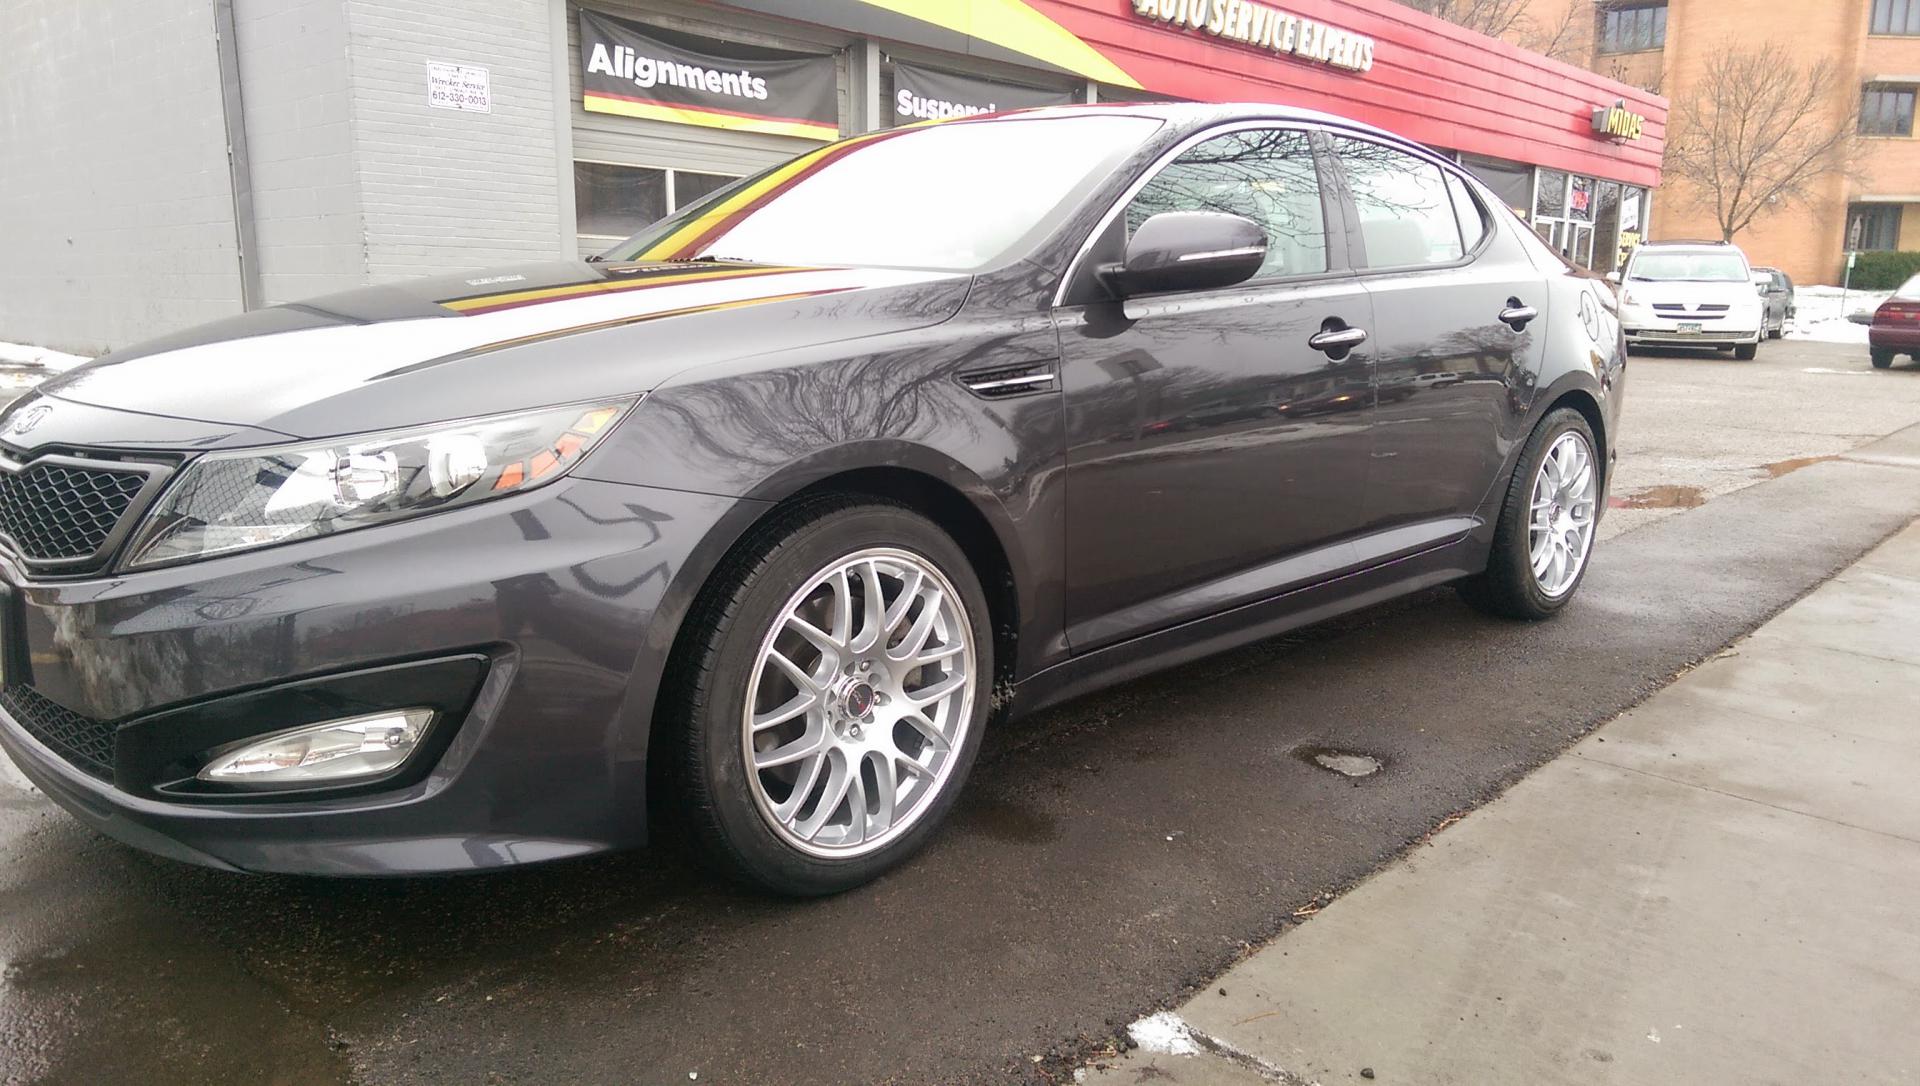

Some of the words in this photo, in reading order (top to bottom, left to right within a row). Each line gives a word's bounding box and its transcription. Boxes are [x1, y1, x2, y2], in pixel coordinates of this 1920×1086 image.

[1207, 0, 1297, 54] SERVICE
[1296, 17, 1375, 72] EXPERTS
[588, 43, 768, 100] Alignments
[432, 90, 487, 106] 612-330-0013
[1607, 106, 1645, 140] MIDAS
